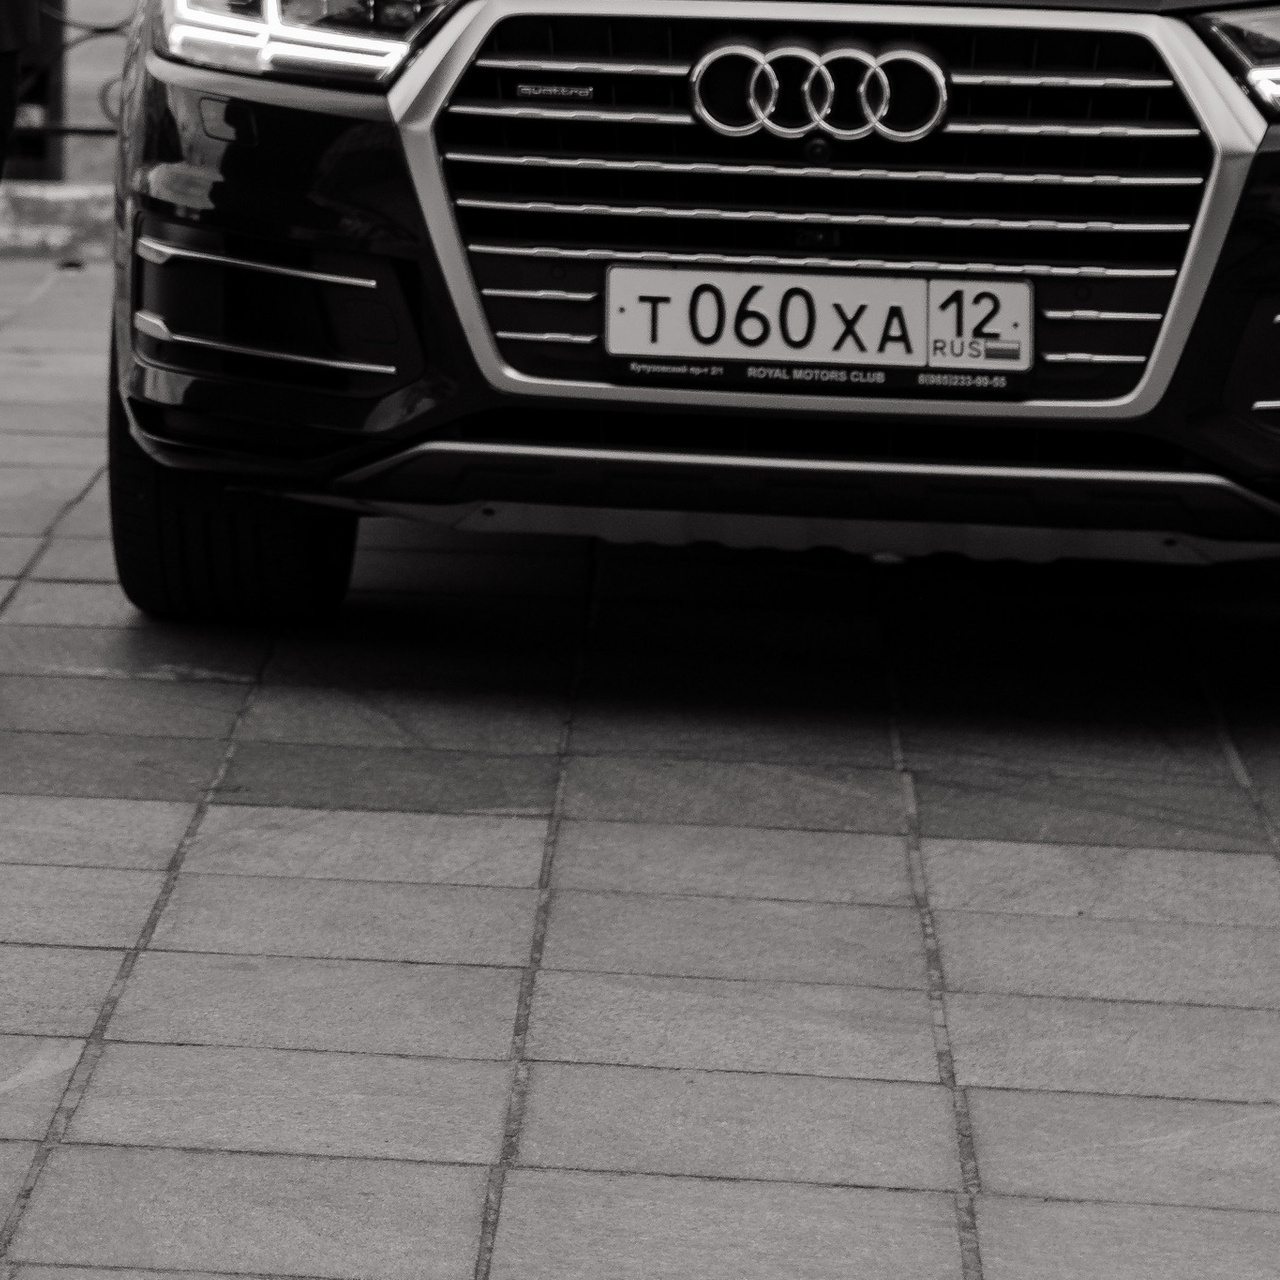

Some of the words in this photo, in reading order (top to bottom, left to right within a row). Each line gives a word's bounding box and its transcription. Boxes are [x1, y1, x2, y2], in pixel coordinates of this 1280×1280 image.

[519, 85, 590, 97] quattro
[938, 289, 1002, 340] 12
[932, 339, 983, 359] RUS
[747, 365, 790, 380] ROYAL
[792, 368, 847, 382] MOTORS
[849, 370, 886, 384] CLUB
